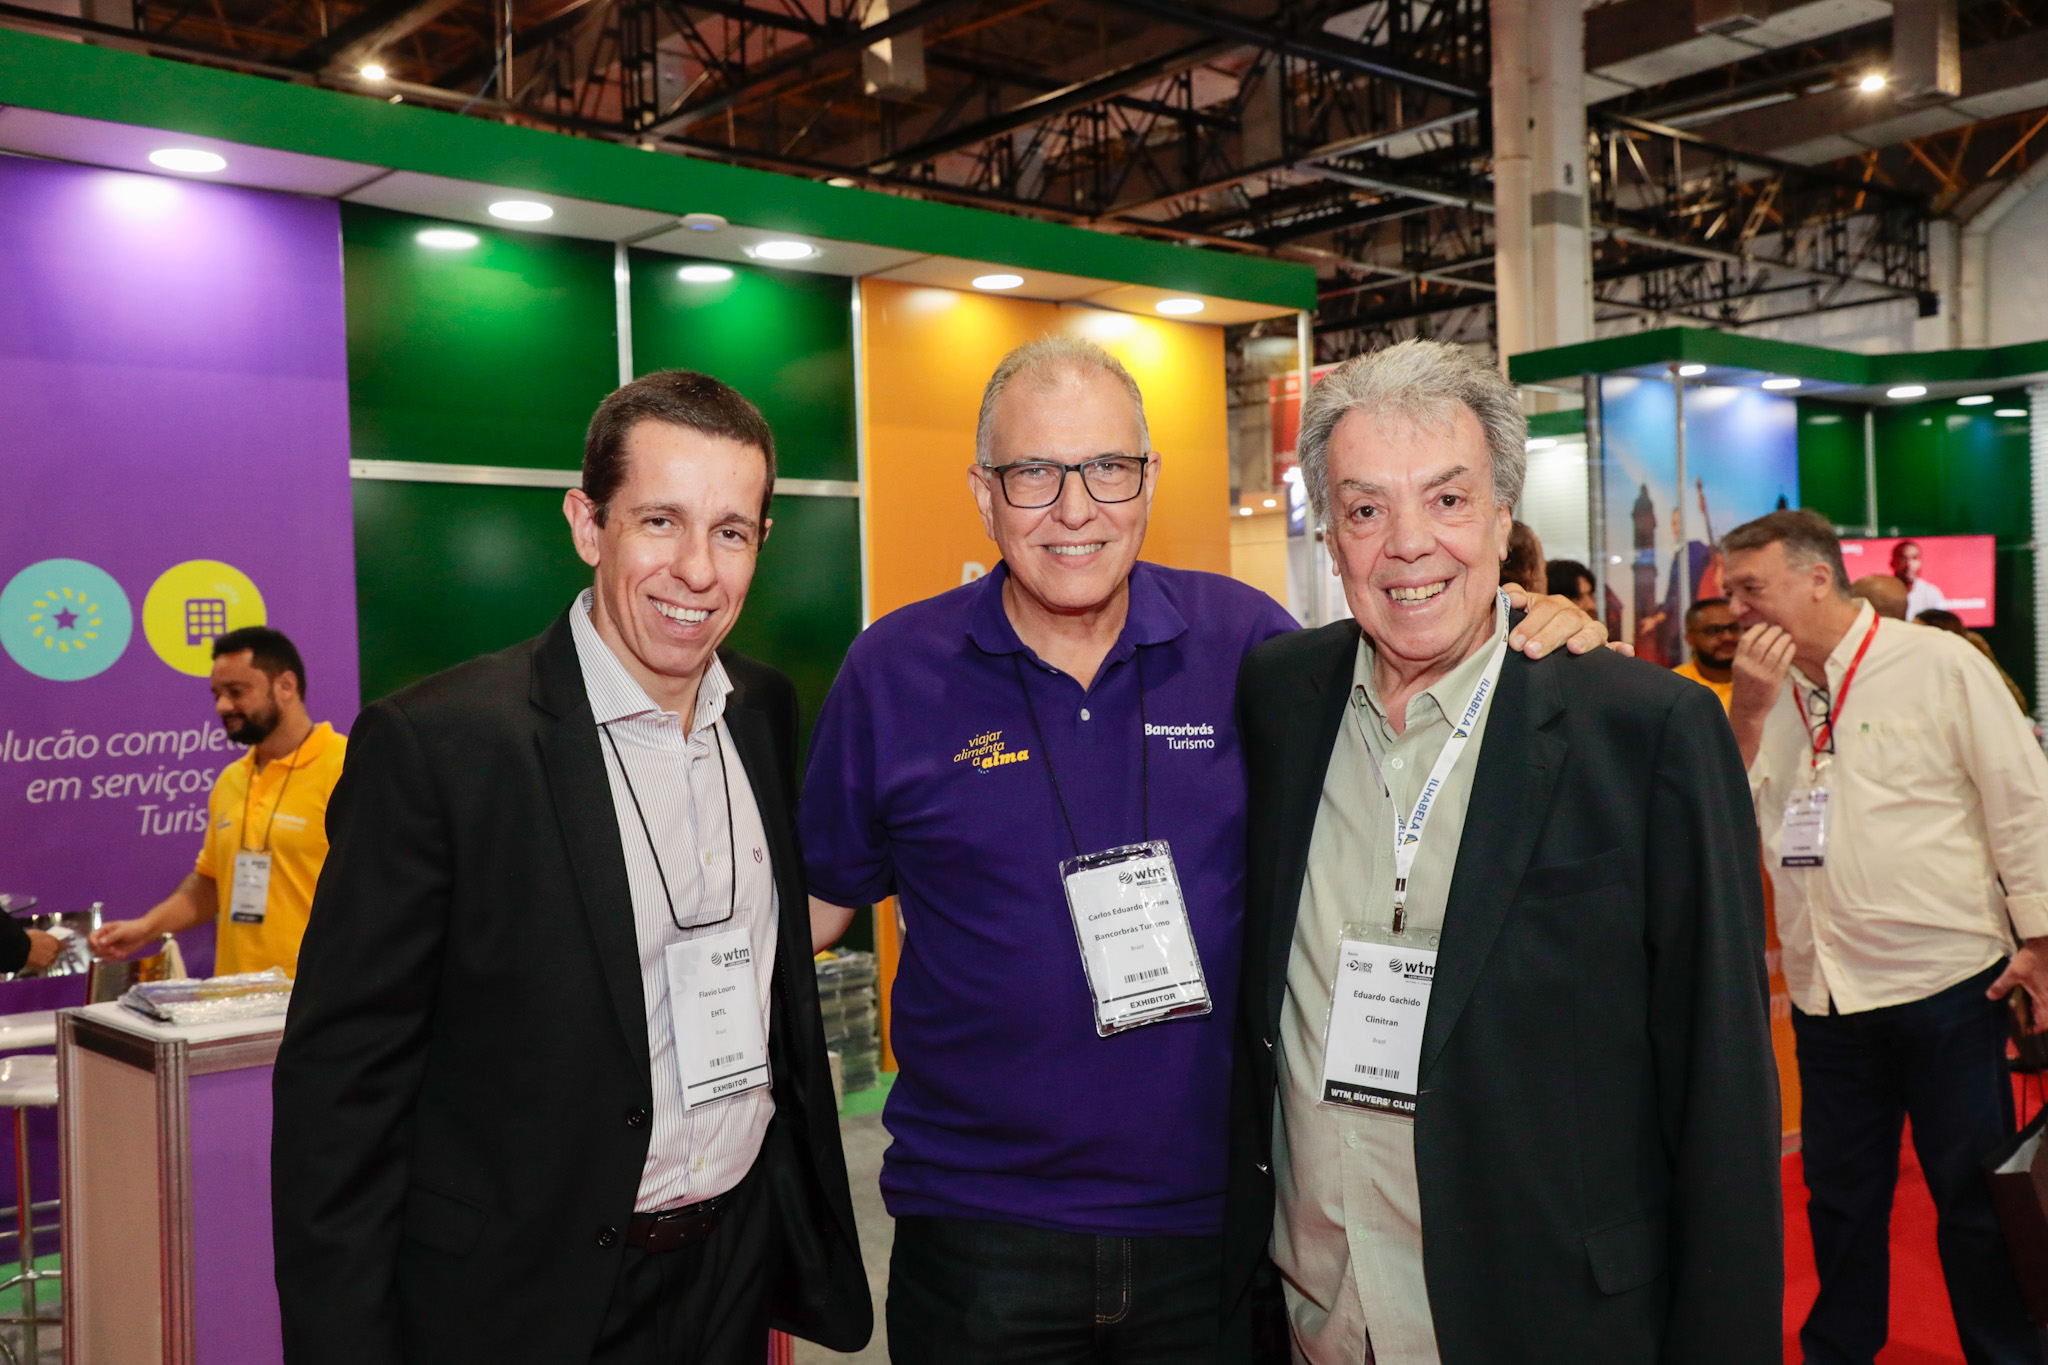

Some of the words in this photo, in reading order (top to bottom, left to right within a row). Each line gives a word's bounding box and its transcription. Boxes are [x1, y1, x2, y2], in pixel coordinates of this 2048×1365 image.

[1461, 678, 1491, 727] ILHABELA
[1144, 723, 1214, 736] Bancorbrás
[0, 729, 100, 762] lucão
[106, 720, 250, 760] comple
[968, 730, 1002, 748] viajar
[1166, 737, 1215, 750] Turismo
[953, 740, 1005, 763] alimenta
[972, 757, 982, 767] a
[981, 749, 1029, 769] alma
[26, 776, 82, 803] em
[90, 765, 215, 802] serviços
[1409, 778, 1440, 830] ILHABELA
[1134, 866, 1165, 879] wtm
[1088, 911, 1111, 921] Carlos
[1112, 904, 1143, 915] Eduardo
[1144, 899, 1169, 909] Prira
[1094, 926, 1138, 941] Bancorbrás
[723, 947, 750, 962] wtm
[1405, 961, 1435, 975] wtm
[698, 988, 717, 999] Flavio
[717, 985, 736, 994] Louro
[1353, 990, 1386, 1002] Eduardo
[1389, 995, 1421, 1007] Gachido
[1130, 992, 1176, 1009] EXHIBITOR
[711, 1008, 727, 1018] EHTL
[1365, 1015, 1399, 1027] Clinitran
[1372, 1037, 1386, 1045] Brazil
[713, 1077, 748, 1094] EXHIBITOR
[1330, 1088, 1351, 1099] WTM
